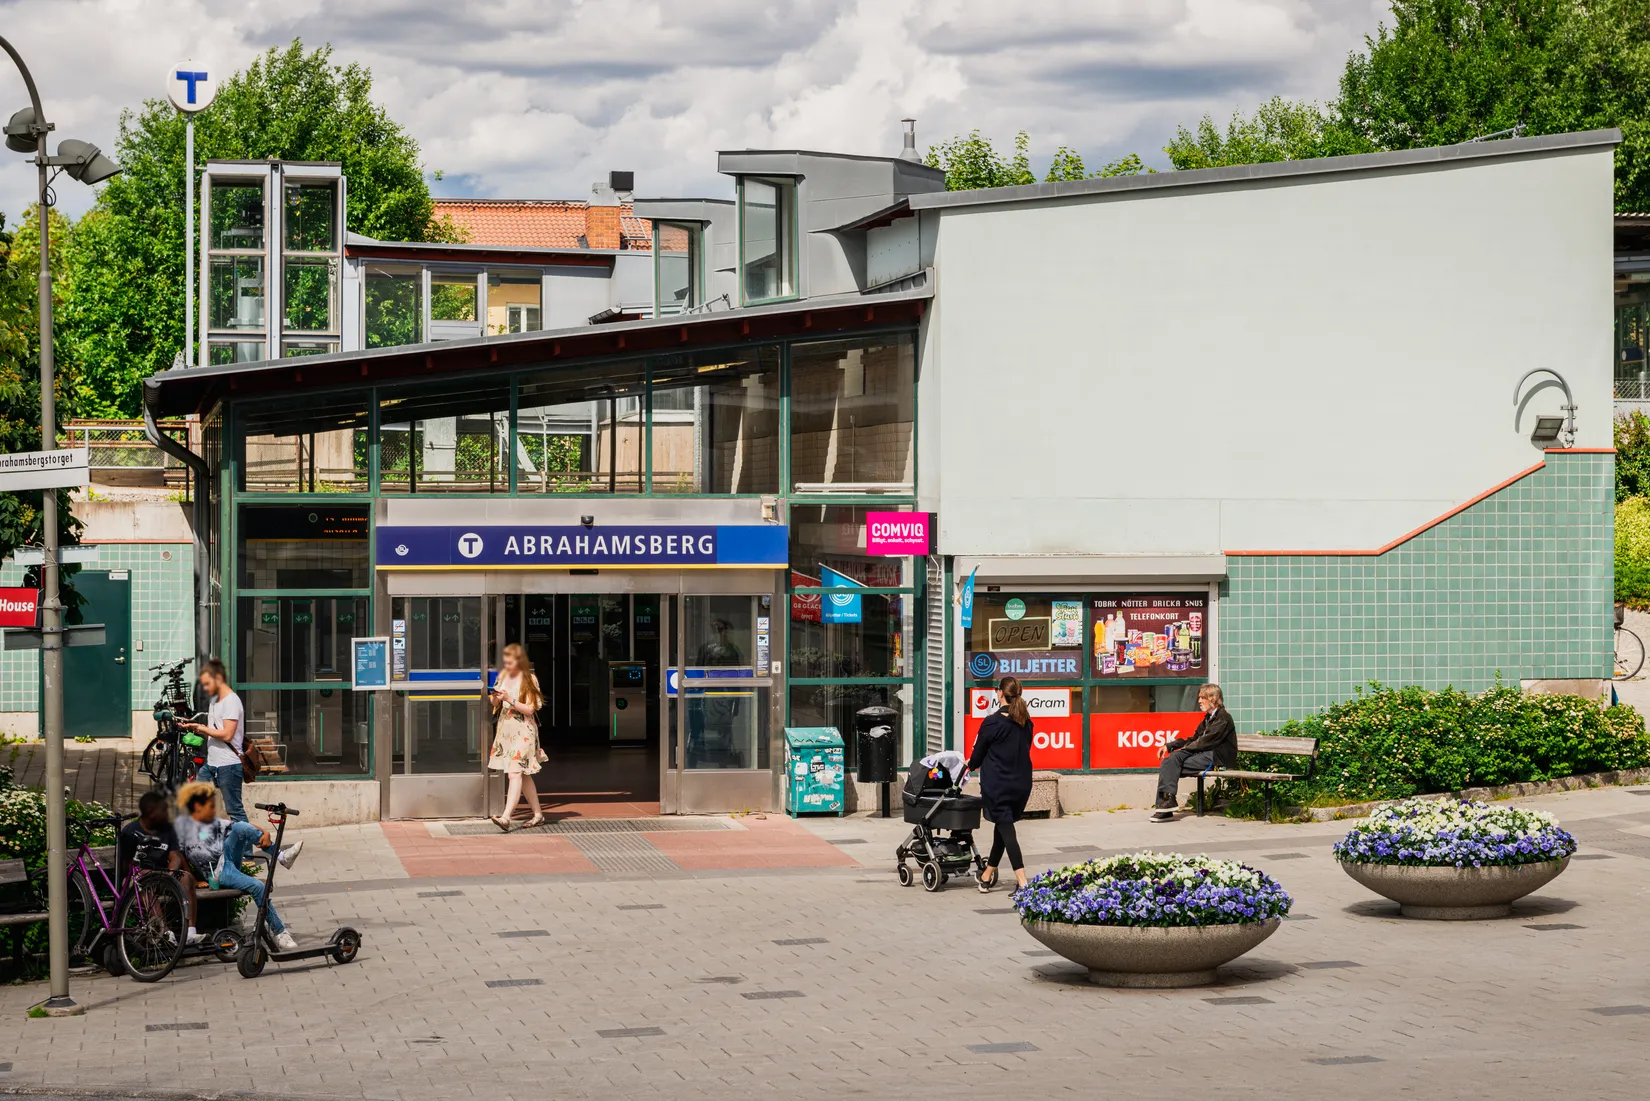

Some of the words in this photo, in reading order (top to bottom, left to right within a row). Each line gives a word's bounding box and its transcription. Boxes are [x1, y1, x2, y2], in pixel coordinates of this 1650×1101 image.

[176, 71, 207, 104] T
[871, 523, 924, 537] COMVIQ
[463, 537, 479, 554] T
[504, 535, 714, 555] ABRAHAMSBERG
[1094, 600, 1117, 608] TOBAK
[1121, 598, 1148, 608] NÖTTER
[1130, 612, 1179, 621] TELEFONKORT
[995, 625, 1045, 643] OPEN
[977, 659, 988, 667] SL
[999, 659, 1077, 673] BILJETTER
[1117, 730, 1180, 748] KIOSK
